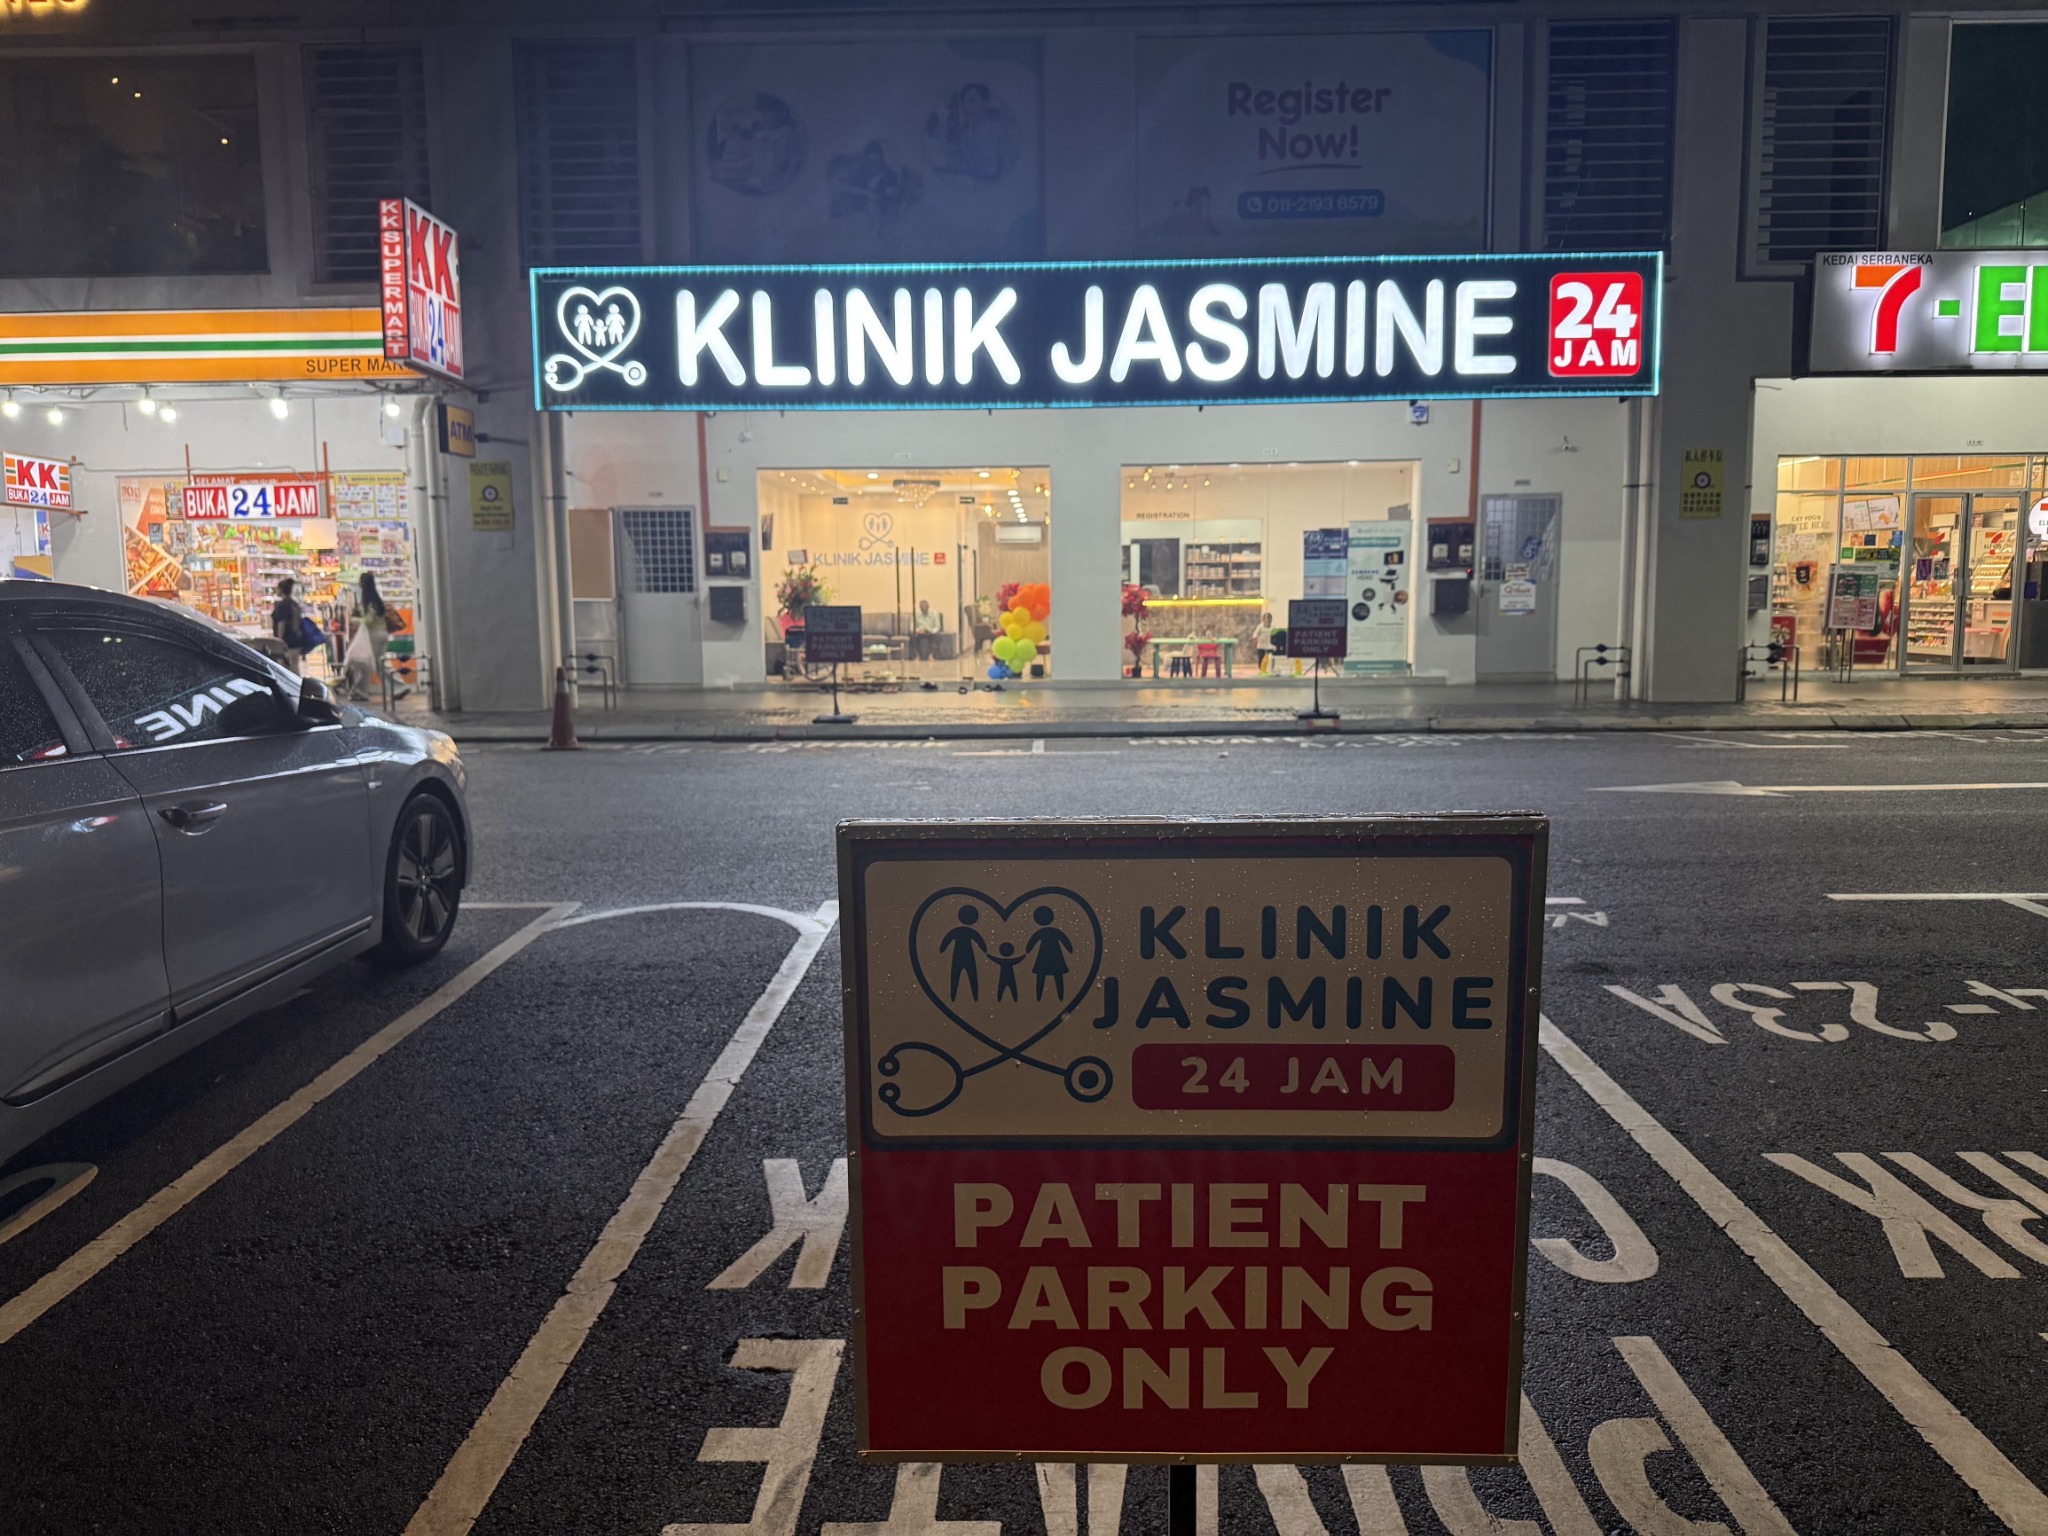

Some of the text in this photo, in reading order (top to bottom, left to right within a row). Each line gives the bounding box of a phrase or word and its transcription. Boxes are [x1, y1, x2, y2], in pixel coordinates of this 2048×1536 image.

[1228, 81, 1391, 125] Register
[1258, 125, 1358, 160] Now!
[1268, 195, 1379, 213] 011-2193 8579
[409, 207, 456, 303] KK
[1823, 254, 1933, 266] KEDAI SERBANEKA
[383, 231, 404, 356] SUPERMART
[1554, 282, 1638, 339] 24
[429, 297, 445, 366] 24
[676, 279, 1517, 386] KLINIK JASMINE
[306, 359, 361, 373] SUPER
[1554, 339, 1638, 367] JAM
[450, 421, 473, 442] ATM
[16, 459, 59, 491] KK
[8, 488, 70, 506] BUKA 24 JAM
[186, 486, 227, 517] BUKA
[233, 487, 272, 517] 24
[275, 486, 317, 515] JAM
[1136, 511, 1190, 519] REGISTRATION
[813, 553, 860, 565] KLINIK
[1293, 638, 1338, 646] PARKING
[1295, 630, 1337, 638] PATIENT
[1302, 646, 1329, 654] ONLY
[1140, 904, 1451, 960] KLINIK
[1092, 976, 1494, 1030] JASMINE
[1180, 1056, 1404, 1094] 24 JAM
[953, 1183, 1427, 1249] PATIENT
[942, 1266, 1434, 1331] PARKING
[1040, 1346, 1335, 1410] ONLY
